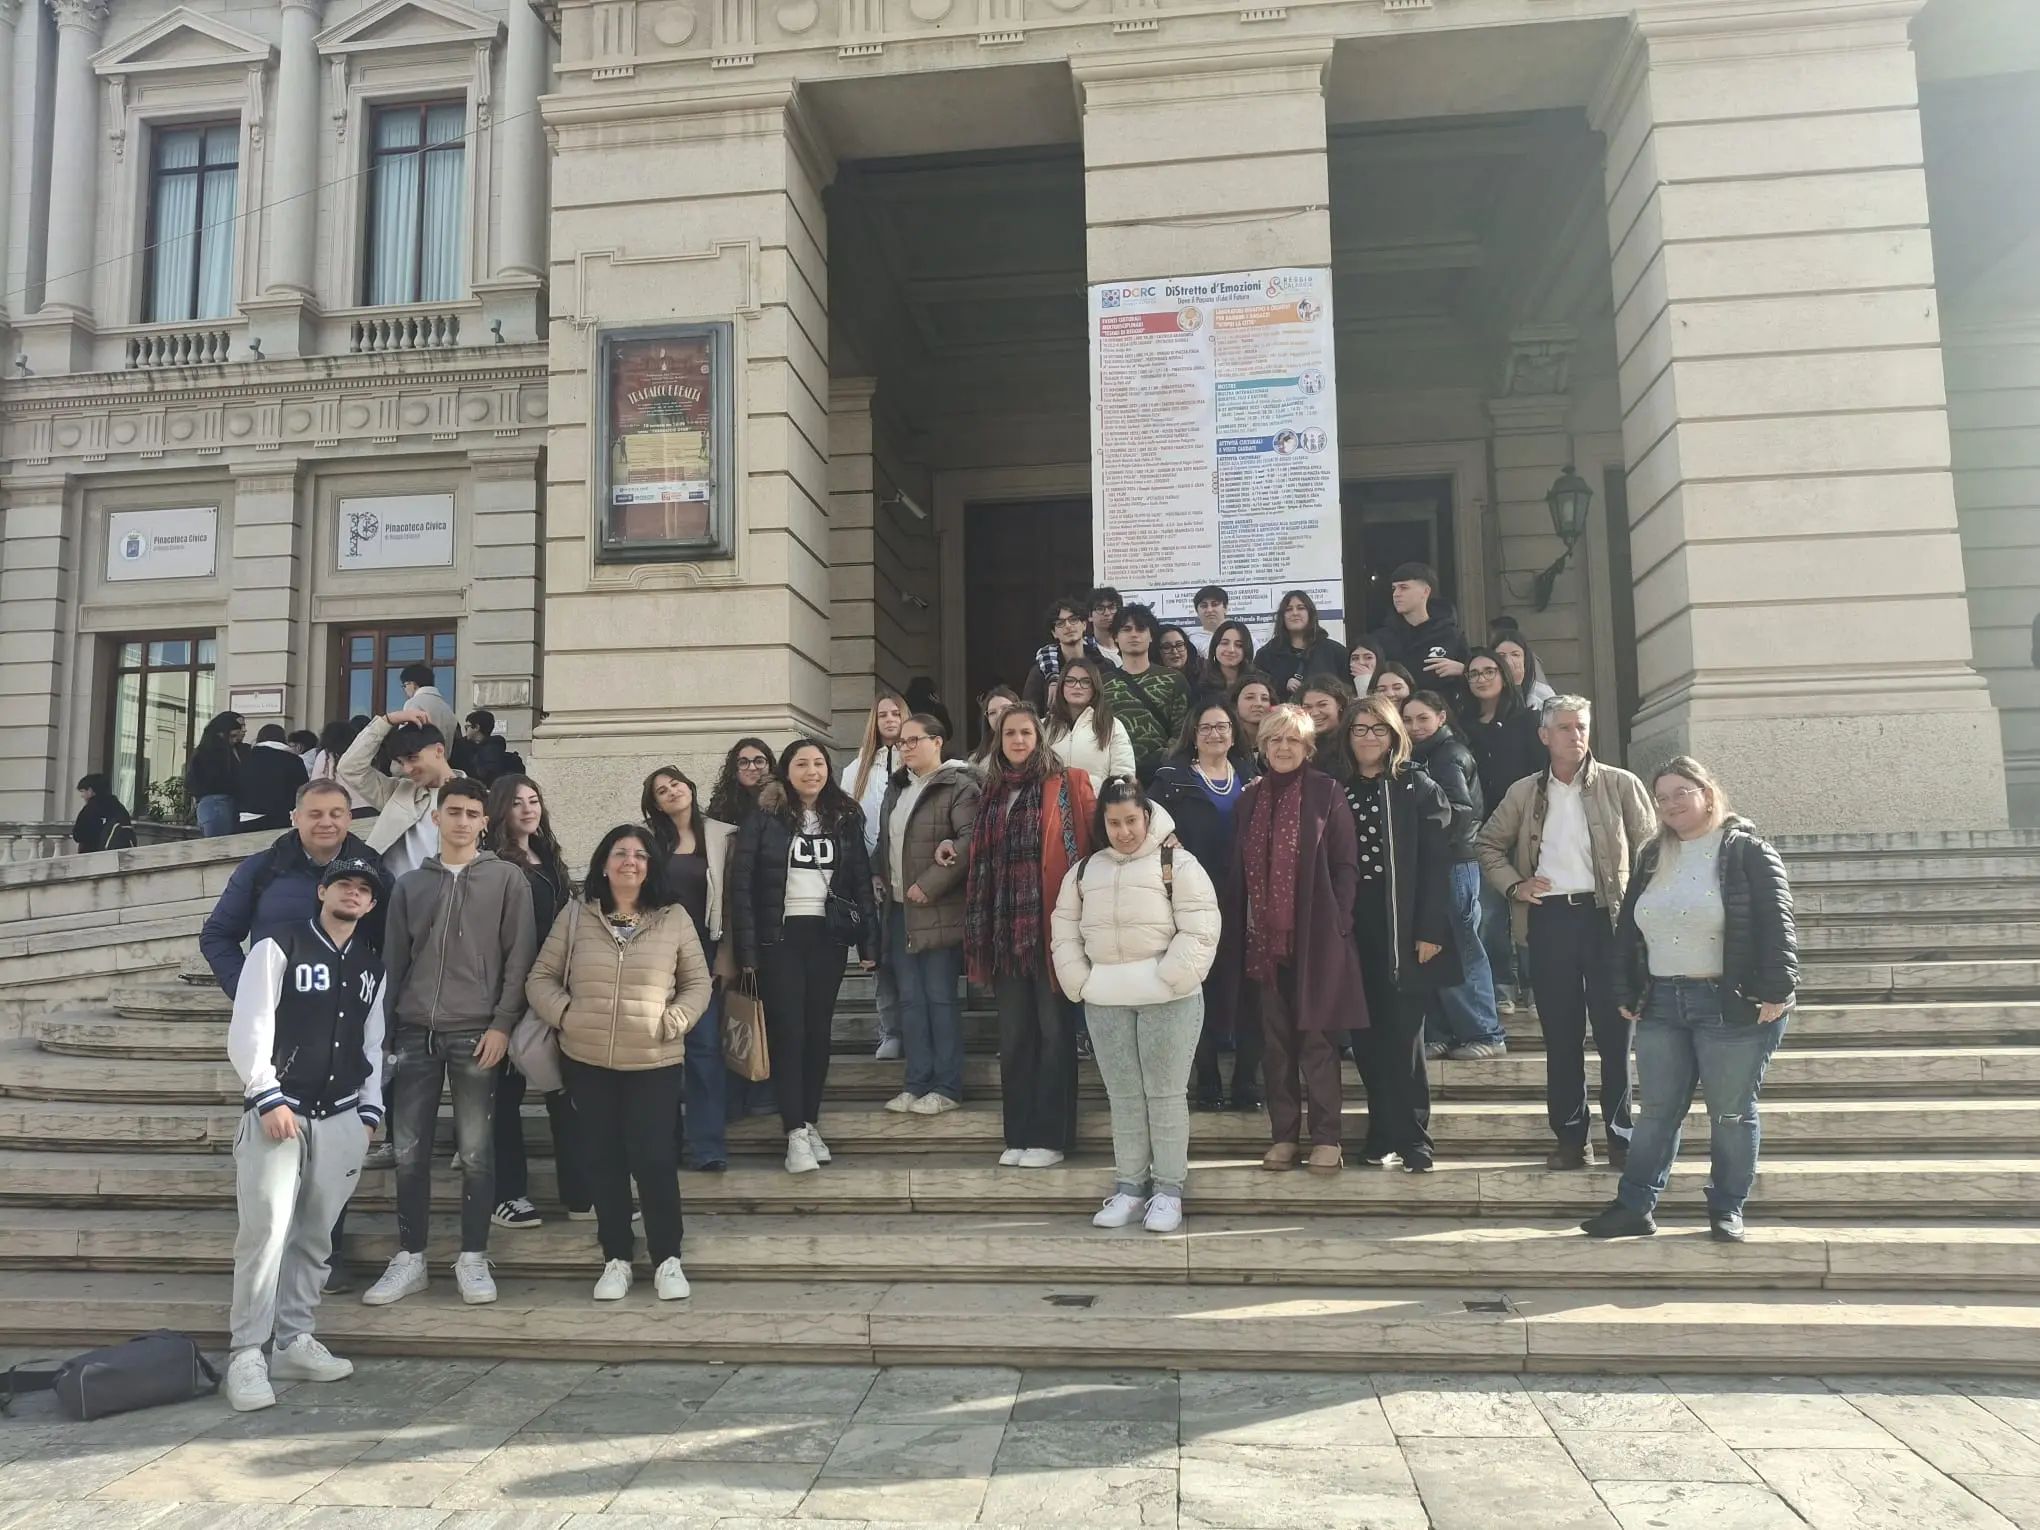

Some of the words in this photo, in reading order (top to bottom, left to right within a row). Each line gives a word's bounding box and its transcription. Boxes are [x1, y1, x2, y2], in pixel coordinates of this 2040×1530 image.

[628, 390, 644, 404] TRA
[644, 385, 666, 400] PALCO
[668, 385, 672, 396] E
[386, 524, 424, 532] Pinacoteca
[426, 522, 446, 531] Civica
[154, 536, 188, 544] Pinacoteca
[188, 534, 208, 542] Civica
[296, 964, 330, 992] 03
